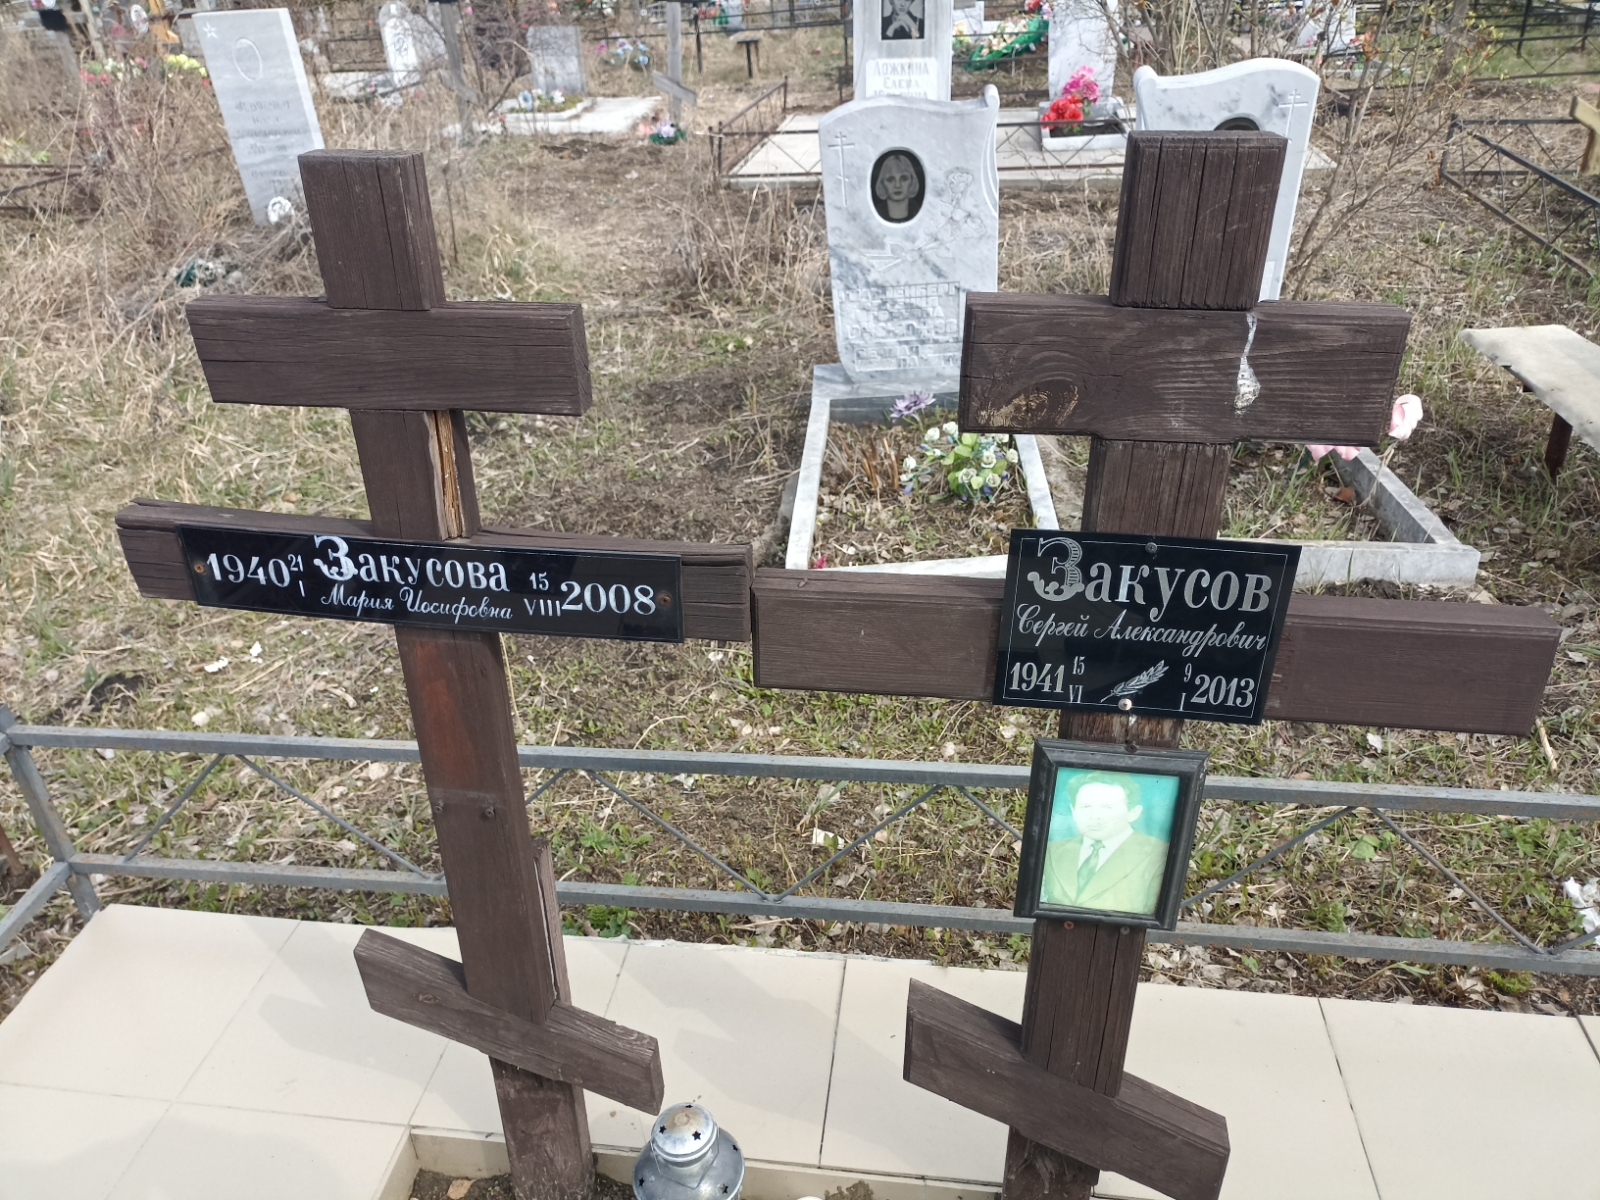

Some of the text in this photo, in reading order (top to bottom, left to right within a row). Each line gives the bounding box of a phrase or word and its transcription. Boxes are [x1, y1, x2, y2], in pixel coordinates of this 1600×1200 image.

[207, 534, 656, 616] 1940 21 Закусова 15 2008
[1027, 536, 1273, 622] Закусов
[321, 583, 513, 624] Мария Иосифовна
[1016, 603, 1268, 658] Сергей Александрович
[1009, 656, 1256, 709] 1941 15 9 2013
